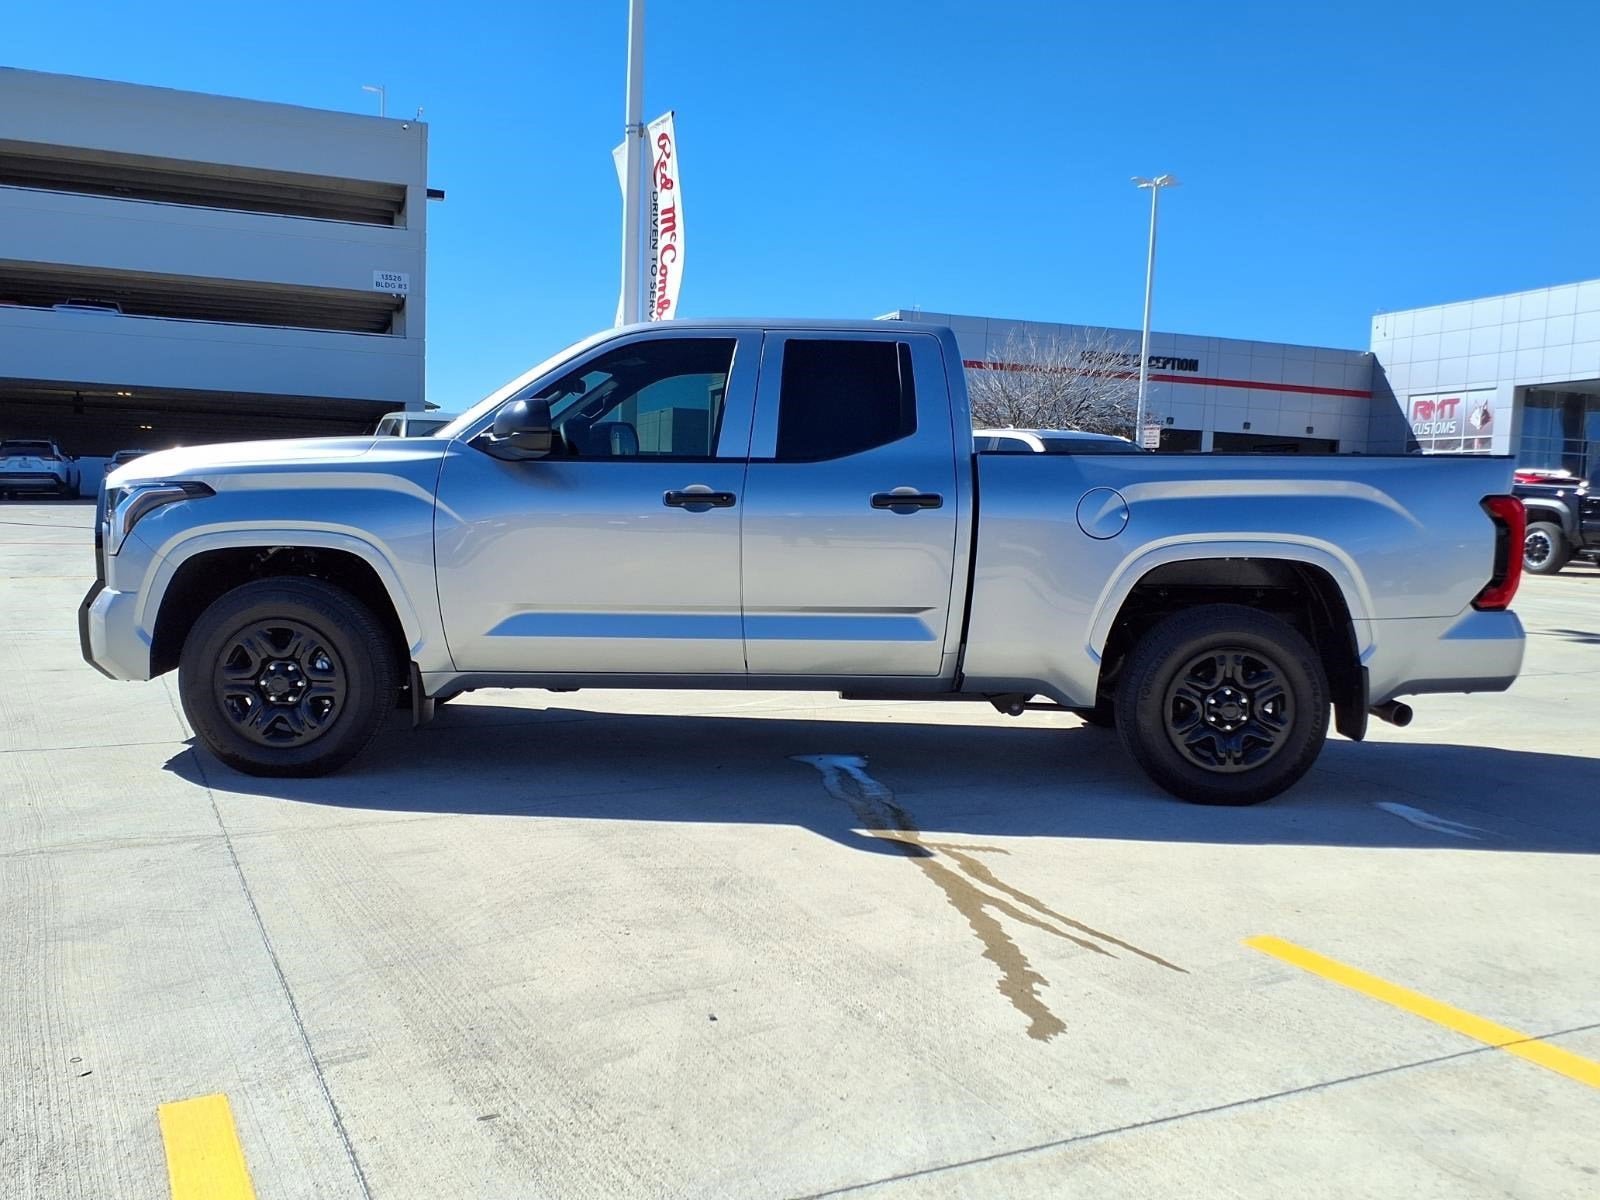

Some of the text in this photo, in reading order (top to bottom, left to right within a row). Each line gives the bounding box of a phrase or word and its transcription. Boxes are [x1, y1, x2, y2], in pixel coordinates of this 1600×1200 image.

[650, 257, 658, 277] TO
[648, 281, 657, 322] SERV
[1413, 421, 1456, 435] CUSTOMS
